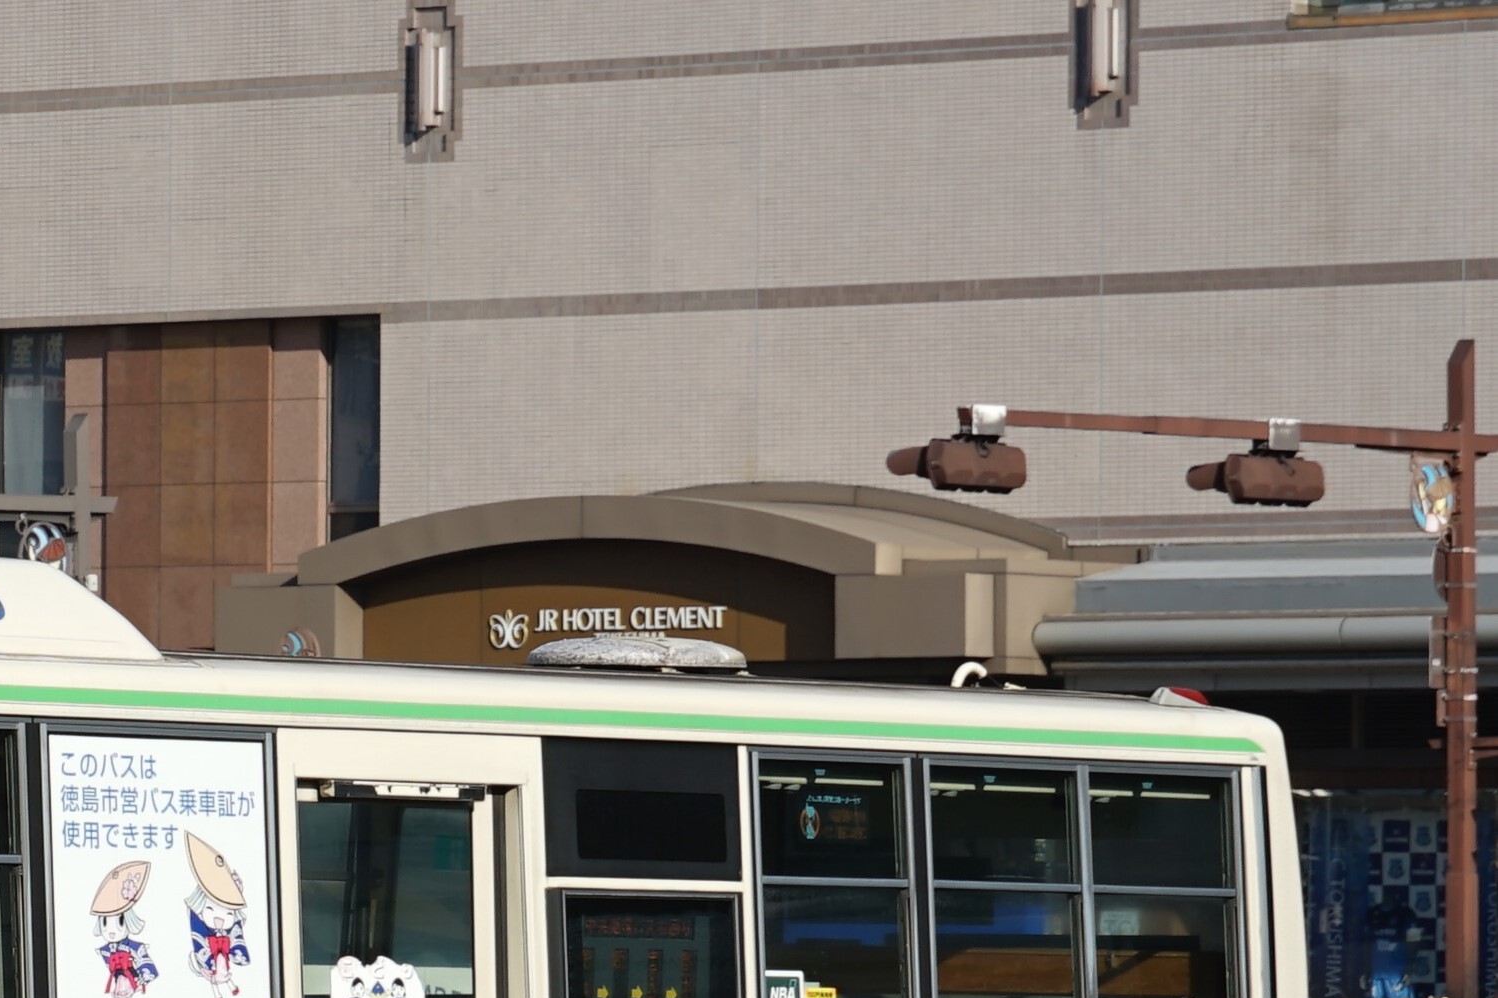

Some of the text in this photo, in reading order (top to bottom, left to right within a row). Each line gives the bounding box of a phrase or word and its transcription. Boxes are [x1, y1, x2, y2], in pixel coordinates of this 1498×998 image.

[534, 606, 727, 632] JR HOTEL CLEMENT
[60, 751, 158, 780] このバスは
[60, 784, 256, 818] 徳島市営バス乗車証が
[62, 820, 179, 850] 使用できます
